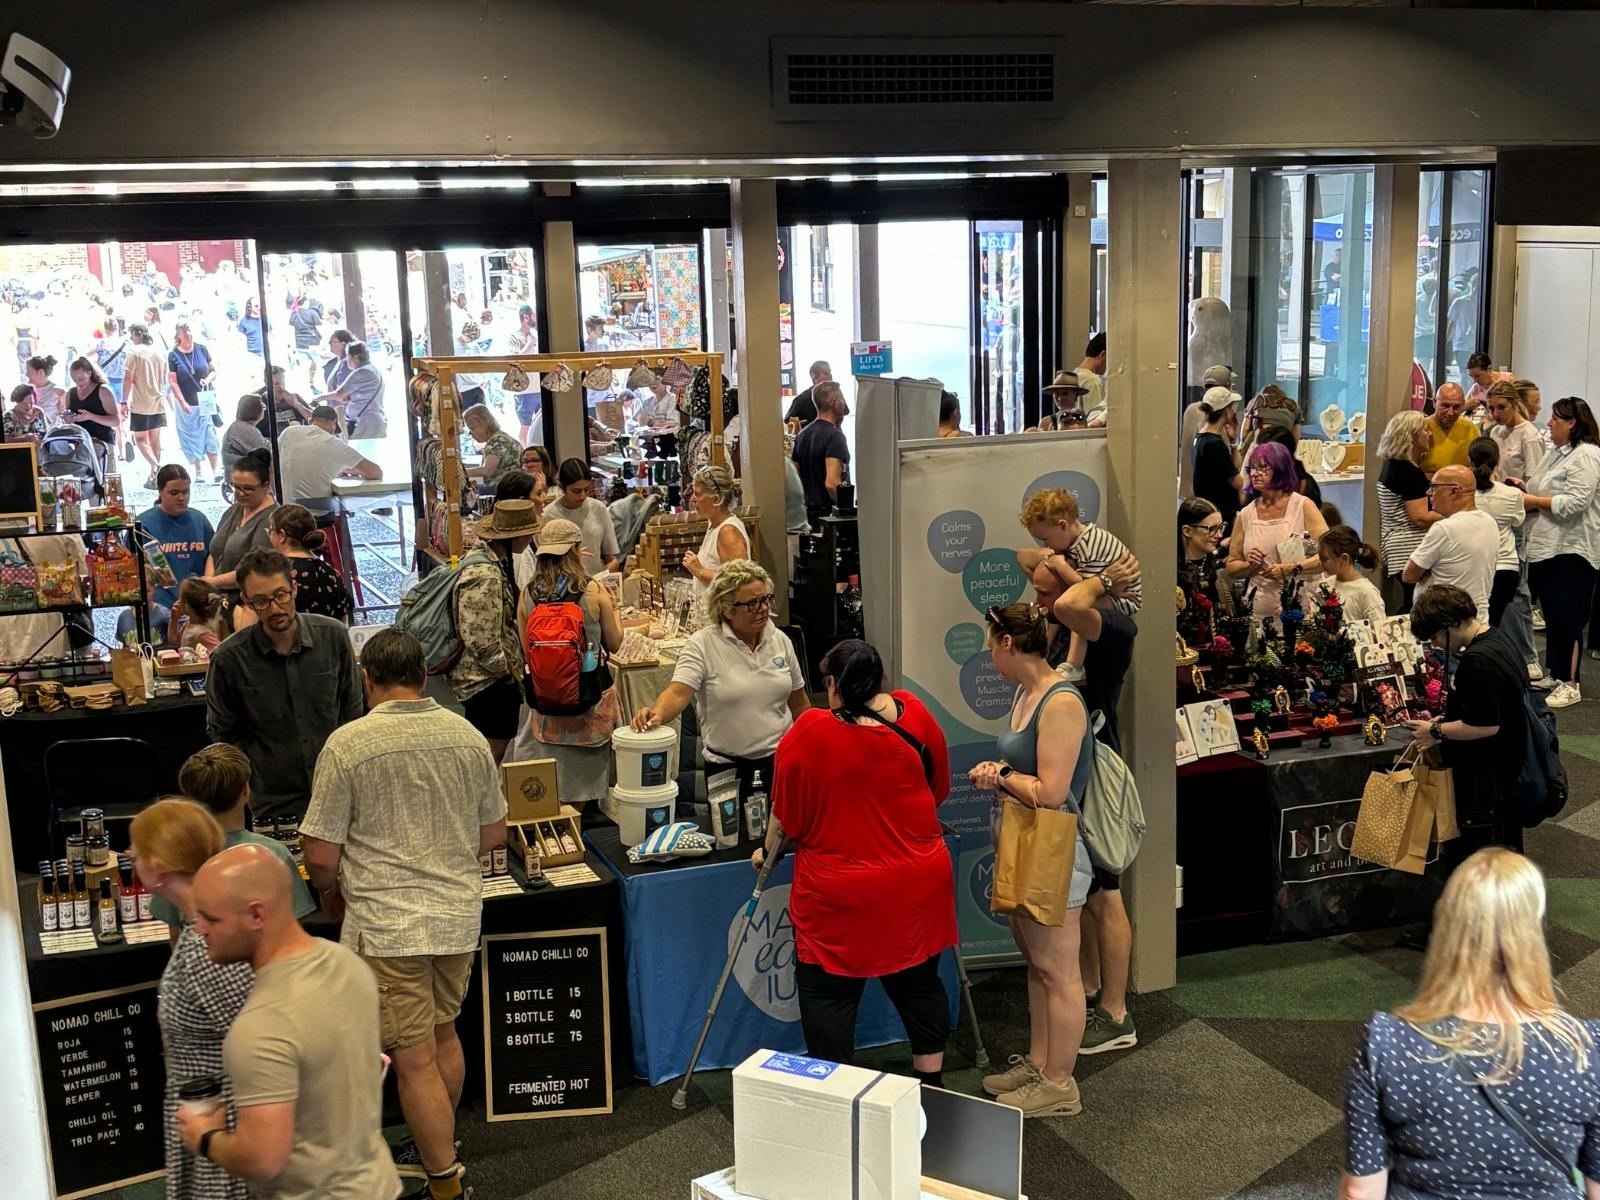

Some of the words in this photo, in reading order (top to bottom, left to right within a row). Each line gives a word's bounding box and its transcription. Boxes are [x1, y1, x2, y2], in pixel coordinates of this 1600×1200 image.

[860, 355, 884, 364] LIFTS
[941, 521, 972, 534] Calms
[160, 542, 188, 553] WHITE
[944, 536, 969, 547] your
[941, 548, 972, 560] nerves
[980, 561, 1011, 573] More
[970, 574, 1020, 592] peaceful
[980, 591, 1009, 604] sleep
[977, 684, 1011, 695] Muscle
[975, 696, 1012, 708] Cramps
[1310, 860, 1326, 873] art
[1330, 855, 1352, 869] and
[502, 950, 539, 963] NOMAD
[541, 948, 572, 960] CHILLI
[576, 947, 589, 958] CO
[505, 992, 510, 1002] 1
[513, 988, 554, 1001] BOTTLE
[569, 987, 581, 998] 15
[51, 1014, 90, 1033] NOMAD
[94, 1007, 123, 1023] CHILL
[128, 1003, 141, 1016] CO
[505, 1013, 512, 1024] 3
[514, 1010, 554, 1024] BOTTLE
[569, 1009, 582, 1020] 40
[57, 1038, 81, 1050] ROJA
[123, 1027, 132, 1036] 15
[506, 1035, 513, 1046] 6
[515, 1032, 555, 1046] BOTTLE
[569, 1031, 583, 1042] 75
[60, 1050, 89, 1064] VERDE
[124, 1040, 134, 1050] 15
[60, 1060, 107, 1078] TAMARIND
[127, 1054, 136, 1063] 15
[63, 1071, 121, 1092] WATERMELON
[129, 1067, 138, 1077] 15
[508, 1080, 566, 1095] FERMENTED
[570, 1078, 589, 1091] HOT
[65, 1090, 101, 1107] REAPER
[531, 1093, 565, 1106] SAUCE
[68, 1114, 97, 1129] CHILLI
[101, 1110, 118, 1121] OIL
[71, 1135, 93, 1147] TRIO
[97, 1128, 121, 1141] PACK
[135, 1122, 145, 1131] 40
